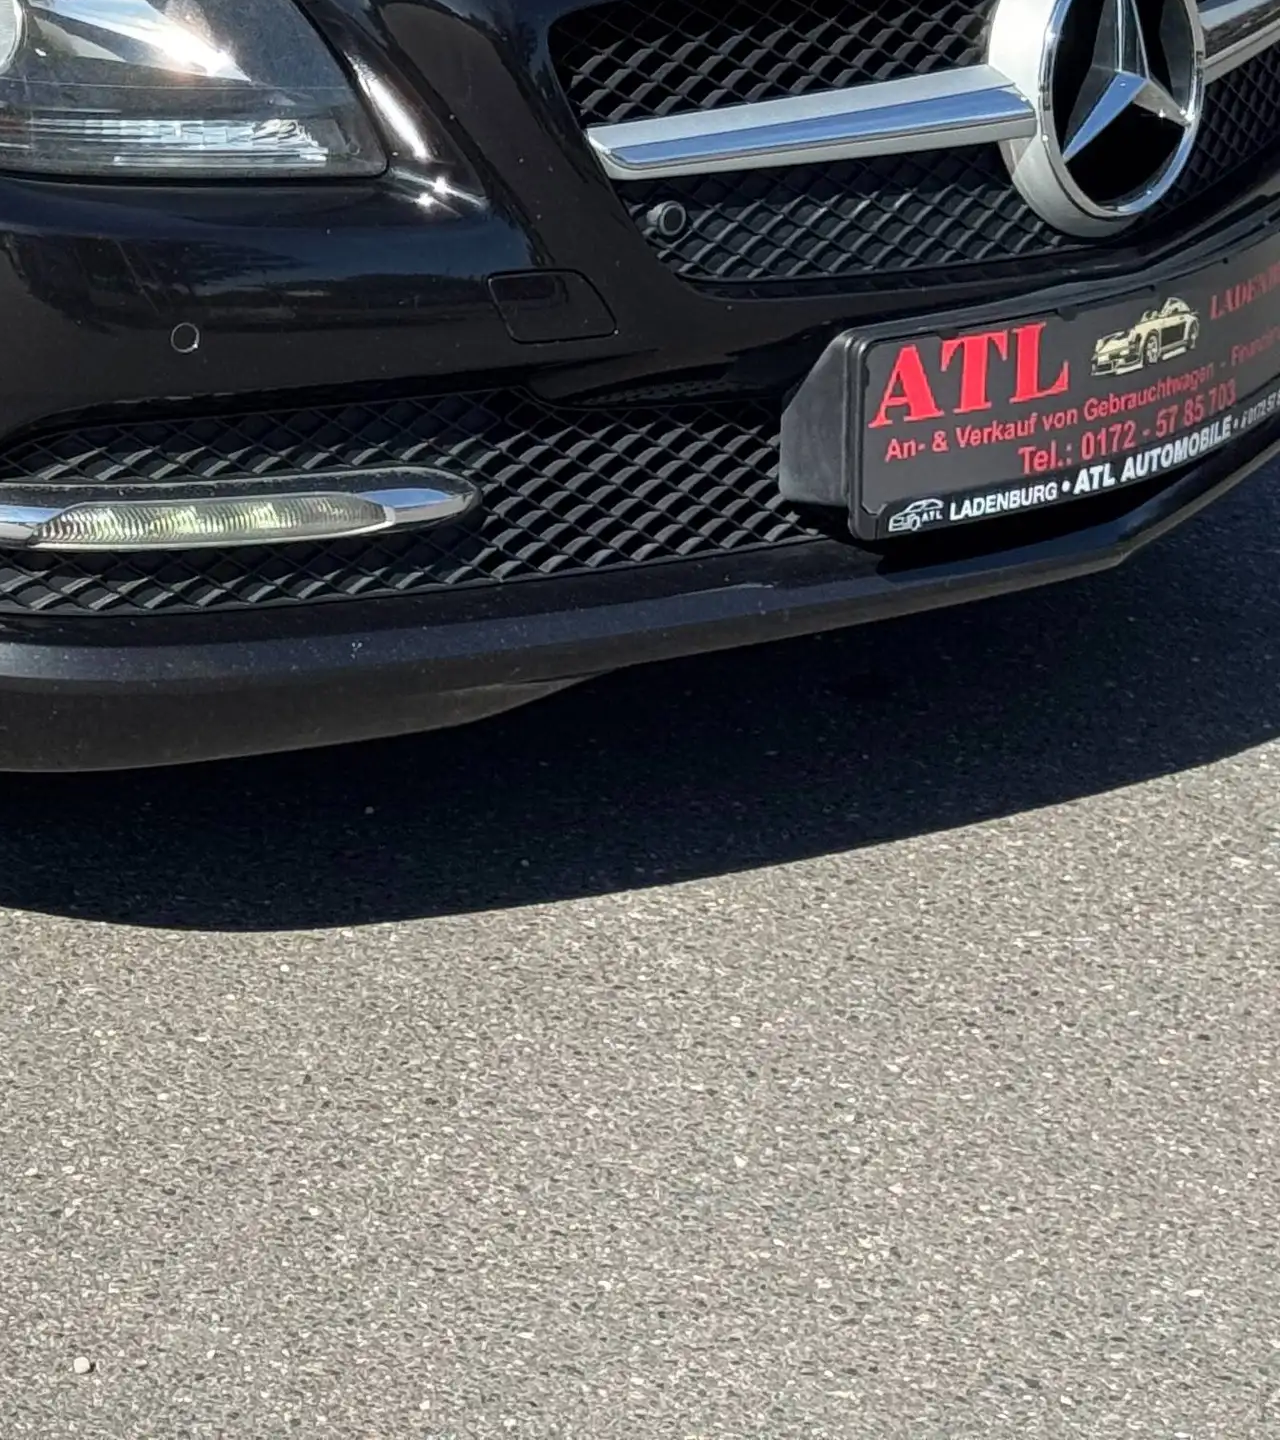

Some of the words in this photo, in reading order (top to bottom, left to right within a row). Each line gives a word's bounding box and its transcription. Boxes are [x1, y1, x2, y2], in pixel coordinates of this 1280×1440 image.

[868, 322, 1069, 428] ATL
[884, 437, 926, 462] An-
[931, 430, 949, 452] &
[955, 412, 1038, 448] Verkauf
[1042, 408, 1078, 432] von
[1083, 363, 1215, 421] Gebrauchtwagen
[949, 481, 1058, 522] LADENBURG
[1072, 463, 1116, 495] ATL
[1120, 414, 1233, 482] AUTOMOBILE
[1017, 439, 1072, 475] Tel.:
[1081, 420, 1137, 461] 0172
[1155, 405, 1179, 438] 57
[1183, 394, 1206, 427] 85
[1208, 377, 1237, 414] 703
[921, 509, 944, 523] ATL
